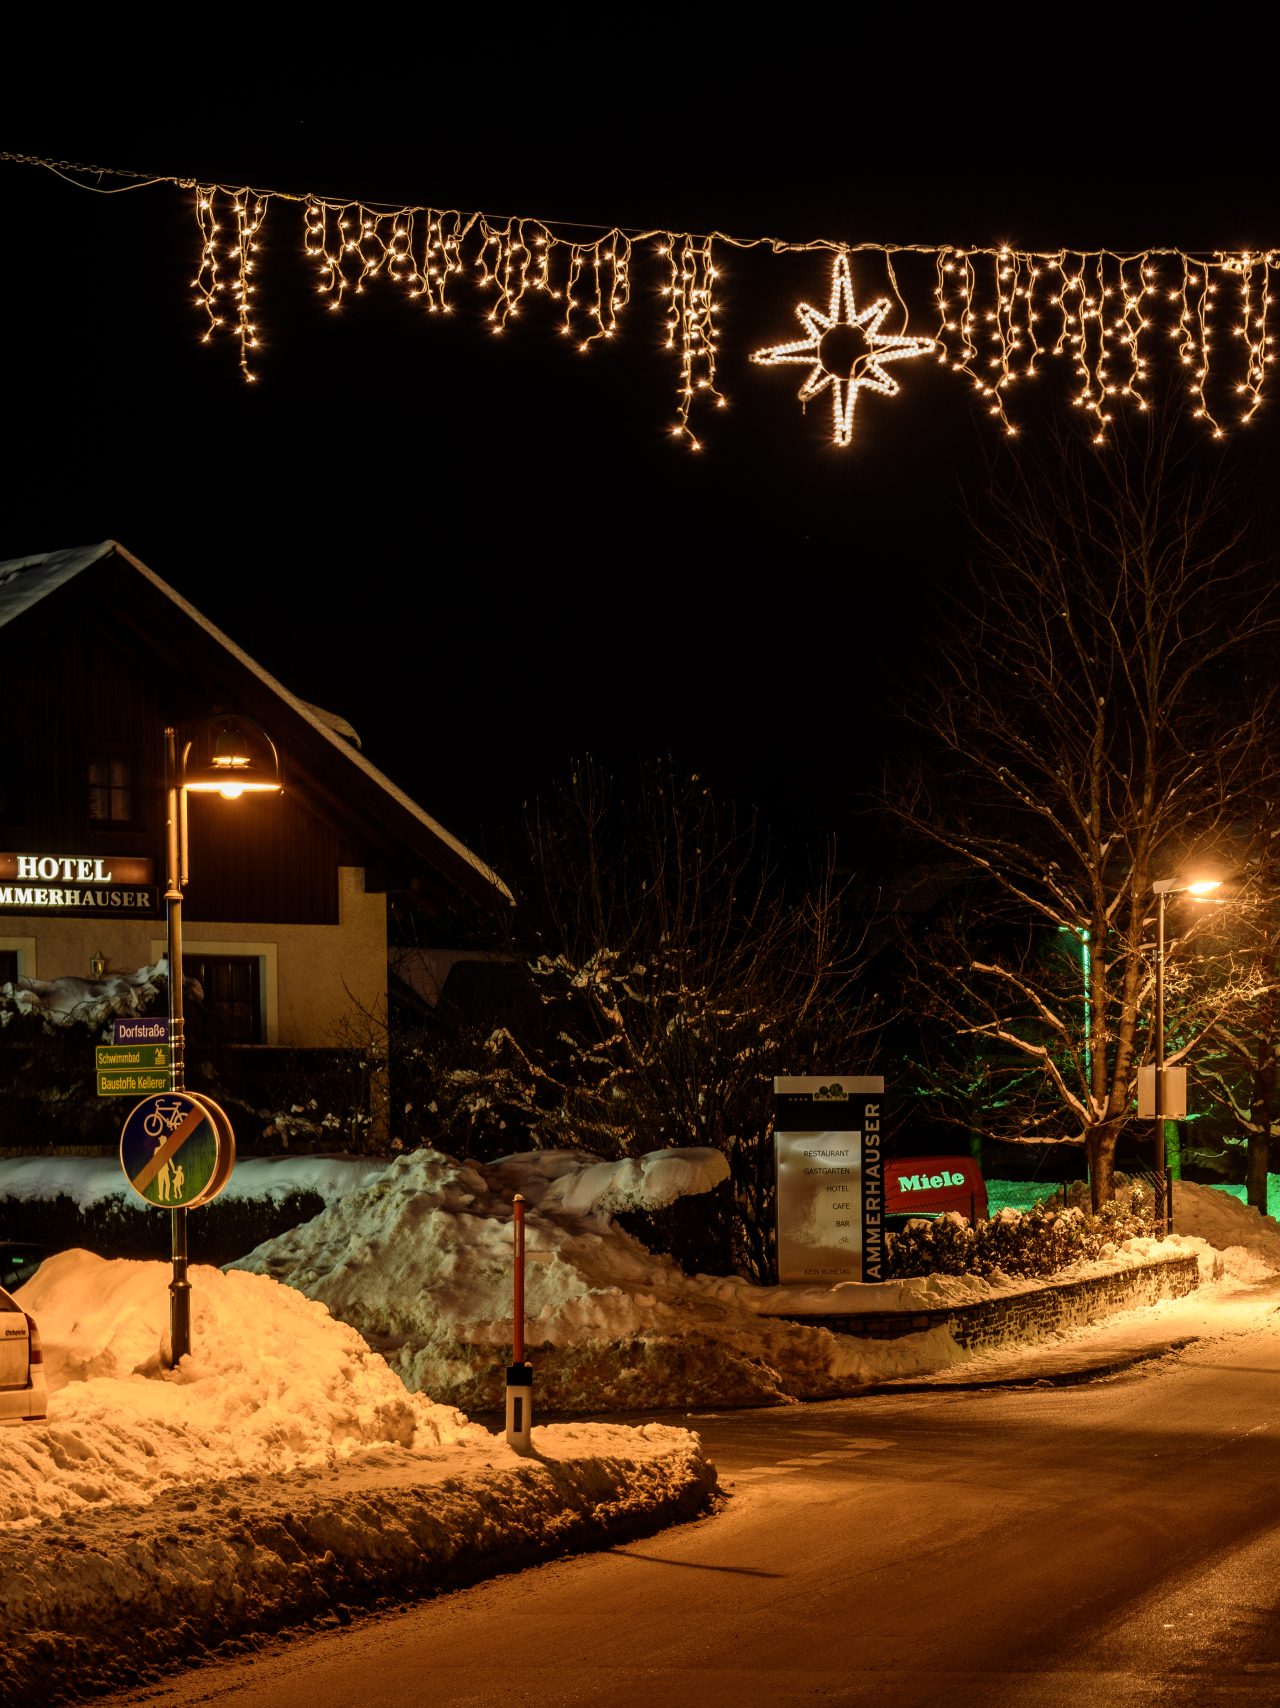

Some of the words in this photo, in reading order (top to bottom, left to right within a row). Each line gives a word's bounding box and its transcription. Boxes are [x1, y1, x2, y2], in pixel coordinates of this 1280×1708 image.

[16, 855, 112, 882] HOTEL
[119, 1023, 166, 1038] Dorfstraße
[98, 1052, 140, 1065] Schwimmbad
[101, 1076, 137, 1090] Baustoffe
[137, 1075, 166, 1089] Kellerer
[803, 1167, 850, 1175] GASTGARTEN
[898, 1171, 965, 1193] Miele
[864, 1103, 882, 1279] AMMERHAUSER
[832, 1202, 850, 1210] CAFE
